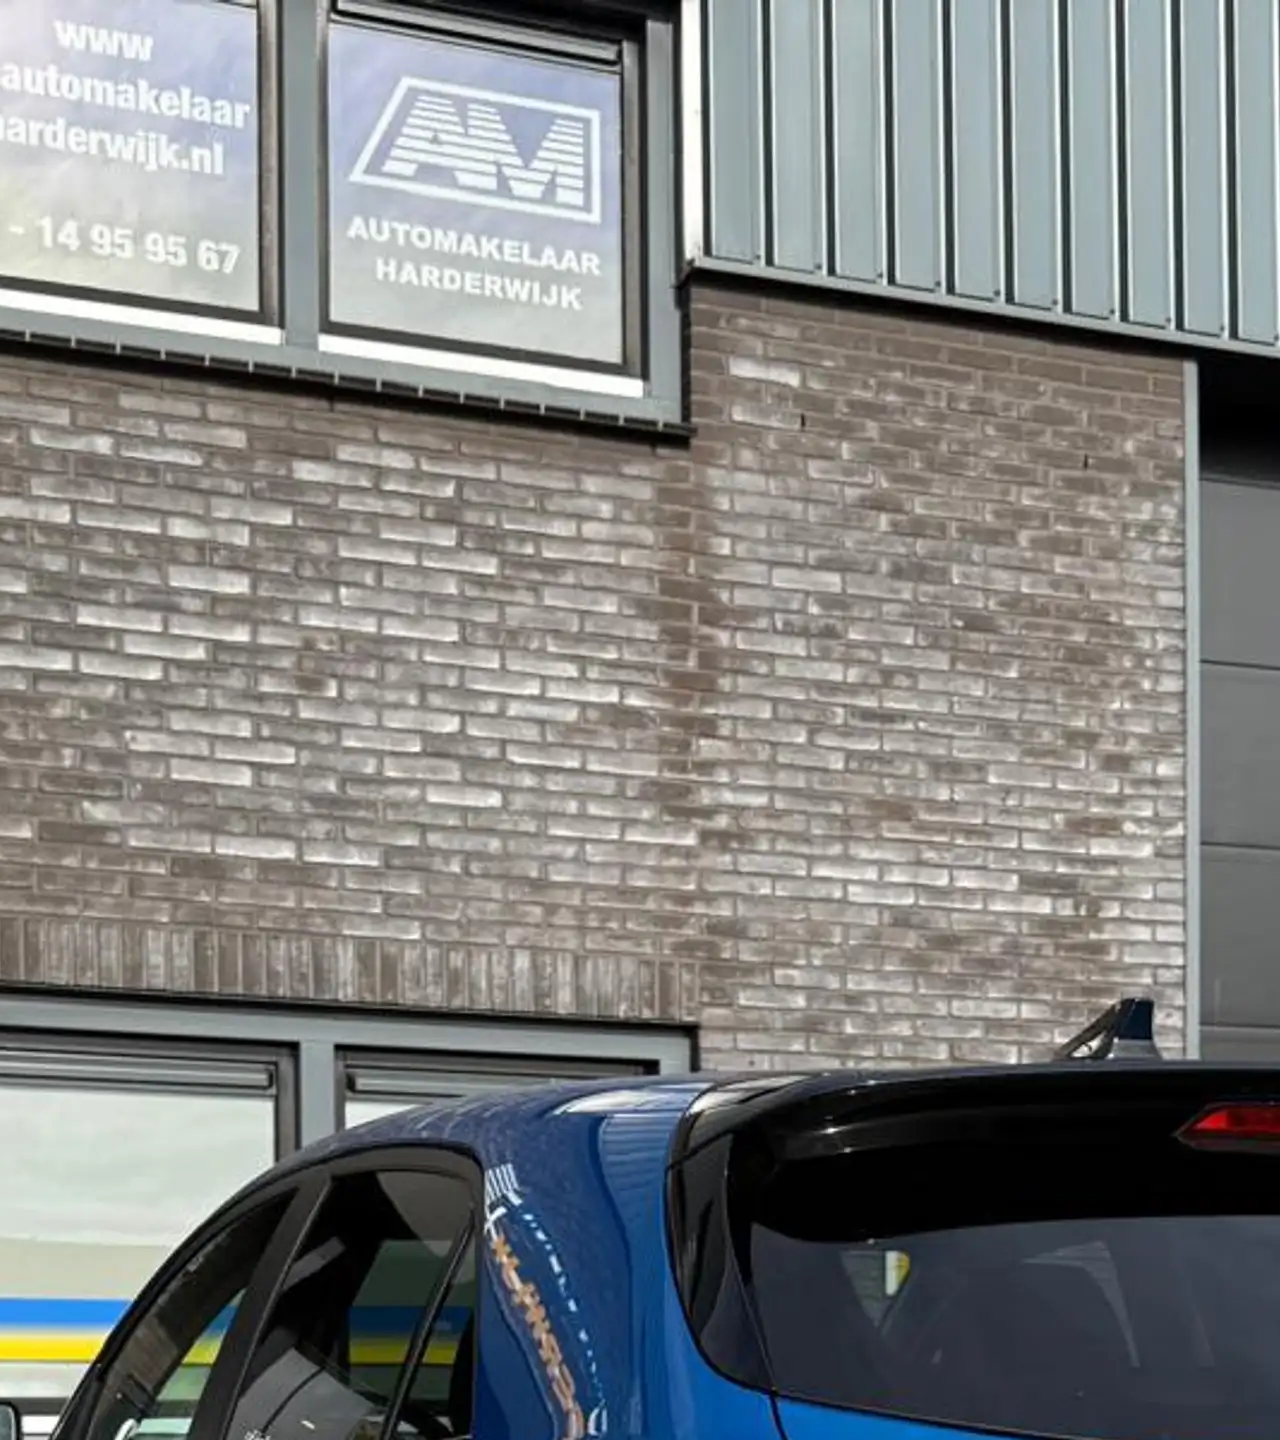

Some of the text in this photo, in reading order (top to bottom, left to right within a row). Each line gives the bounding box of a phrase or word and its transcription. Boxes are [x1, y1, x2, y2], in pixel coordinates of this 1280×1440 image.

[54, 20, 153, 61] www
[381, 95, 584, 208] AM
[36, 216, 81, 251] 14
[90, 224, 134, 259] 95
[145, 233, 188, 267] 95
[198, 241, 240, 274] 67
[346, 216, 601, 276] AUTOMAKELAAR
[376, 257, 583, 310] HARDERWIJK
